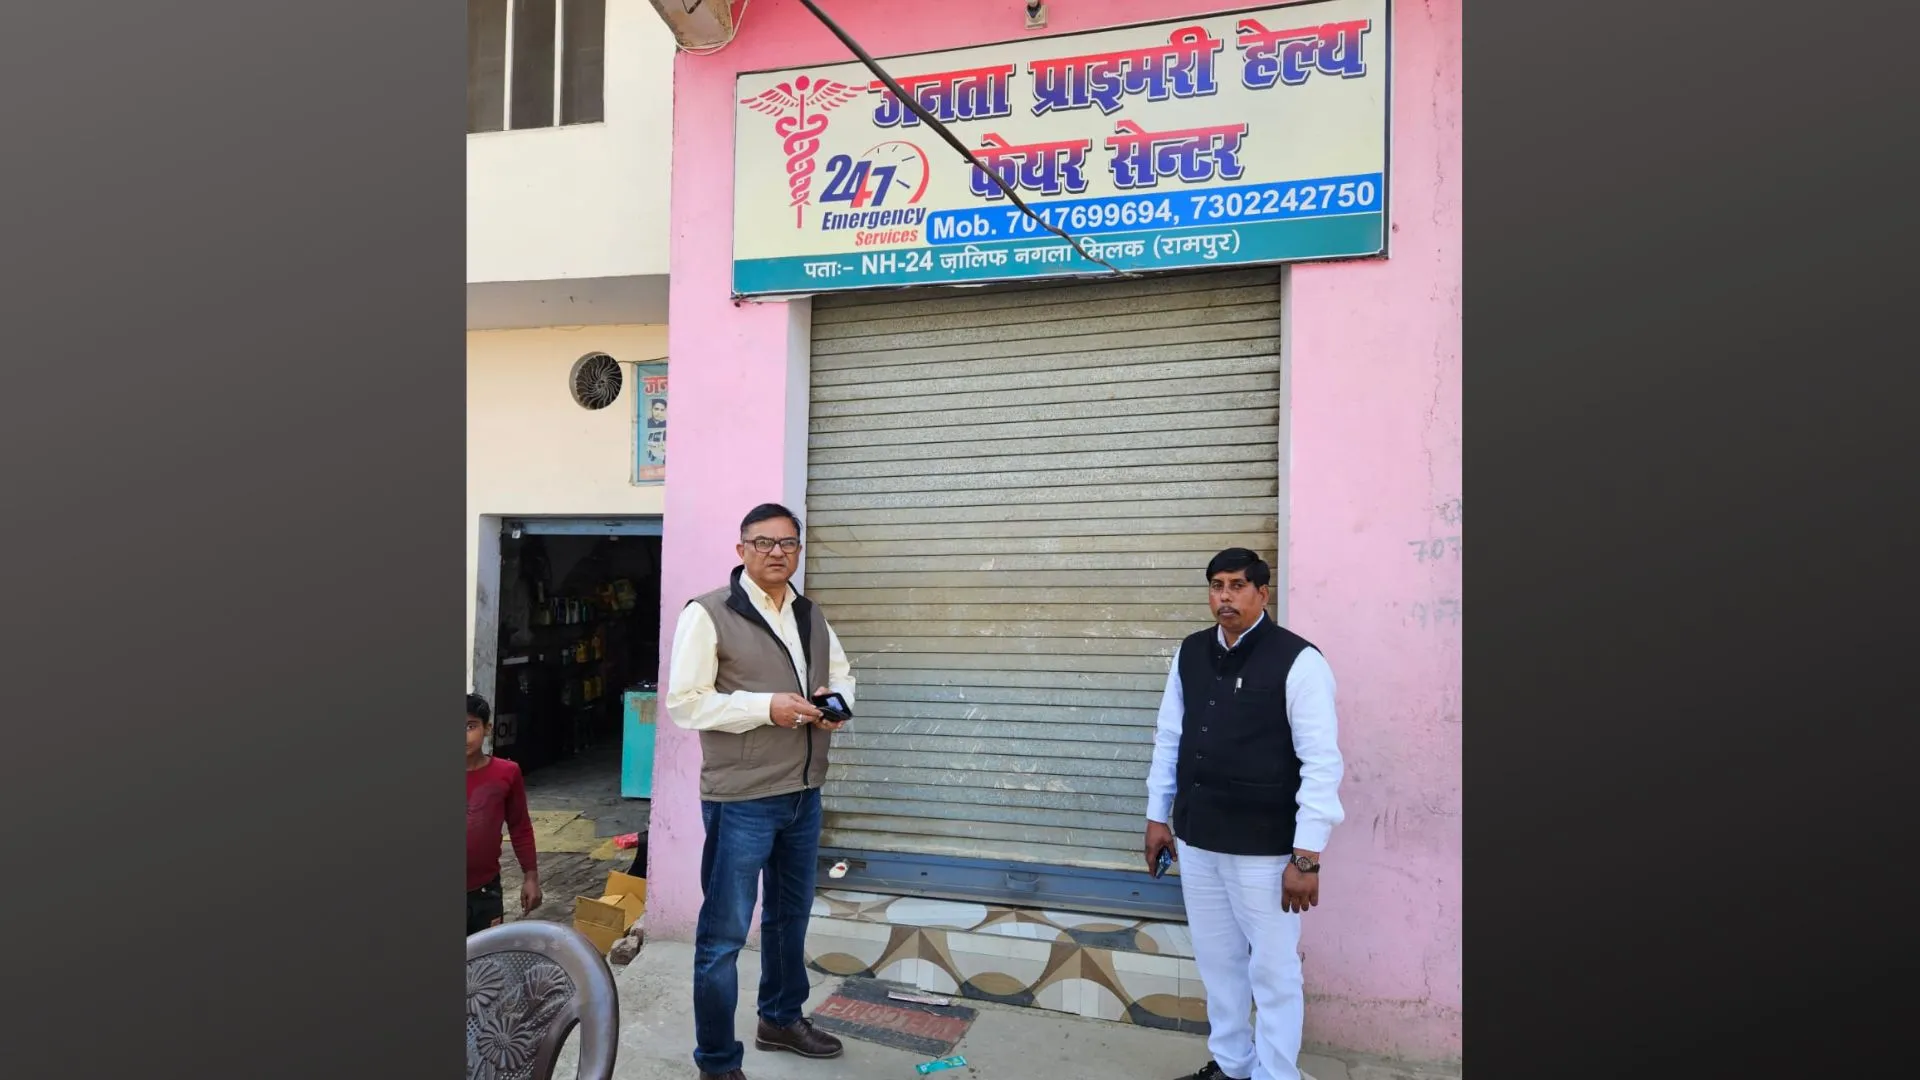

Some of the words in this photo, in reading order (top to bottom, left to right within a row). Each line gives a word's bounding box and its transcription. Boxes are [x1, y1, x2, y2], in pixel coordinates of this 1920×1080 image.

[867, 64, 1015, 127] जनता
[1028, 26, 1222, 115] प्राइमरी
[1236, 18, 1370, 88] हेल्थ
[965, 132, 1091, 199] केयर
[1105, 119, 1247, 188] सेन्टर
[822, 207, 926, 231] Emergency
[933, 214, 997, 240] Mob.
[1006, 198, 1180, 234] 7017699694,
[1190, 181, 1375, 220] 7302242750
[855, 228, 918, 246] Services
[862, 250, 933, 275] NH-24
[1014, 243, 1073, 264] नगला
[1080, 236, 1145, 260] मिलक
[1154, 229, 1240, 259] (रामपुर)
